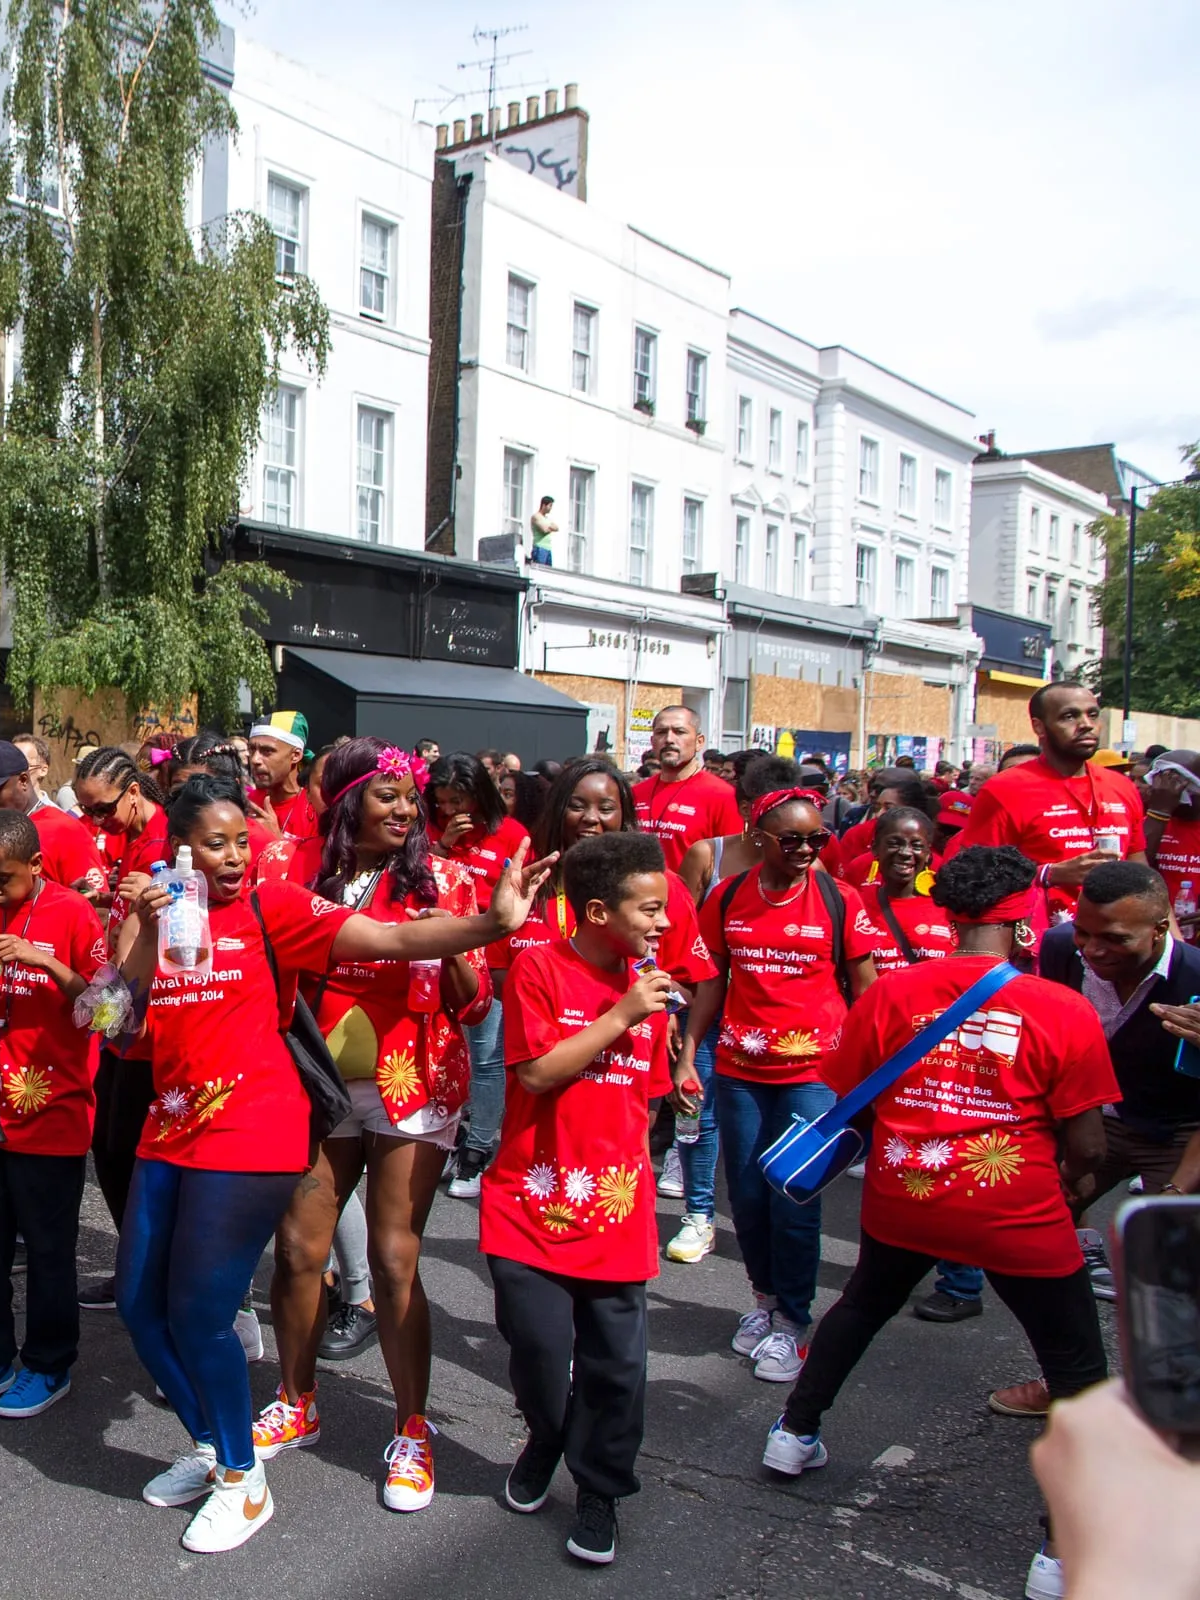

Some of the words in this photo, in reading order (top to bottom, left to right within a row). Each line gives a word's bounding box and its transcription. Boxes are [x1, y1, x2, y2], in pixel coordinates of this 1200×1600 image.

[730, 946, 763, 958] arnival
[766, 948, 817, 962] Mayhem
[871, 948, 898, 957] nival
[765, 963, 780, 973] Hill
[184, 969, 242, 986] Mayhem
[182, 992, 199, 1003] Hill
[201, 990, 224, 1002] 2014
[921, 1056, 943, 1066] YEAR
[944, 1058, 958, 1068] OF
[961, 1062, 976, 1073] THE
[979, 1066, 998, 1076] BUS
[924, 1077, 939, 1087] Year
[941, 1081, 953, 1090] of
[954, 1083, 971, 1094] the
[973, 1086, 992, 1096] Bus
[904, 1086, 921, 1095] and
[936, 1091, 964, 1104] BAME
[966, 1096, 1012, 1111] Network
[894, 1096, 939, 1112] supporting
[941, 1104, 958, 1114] the
[961, 1108, 1020, 1122] community
